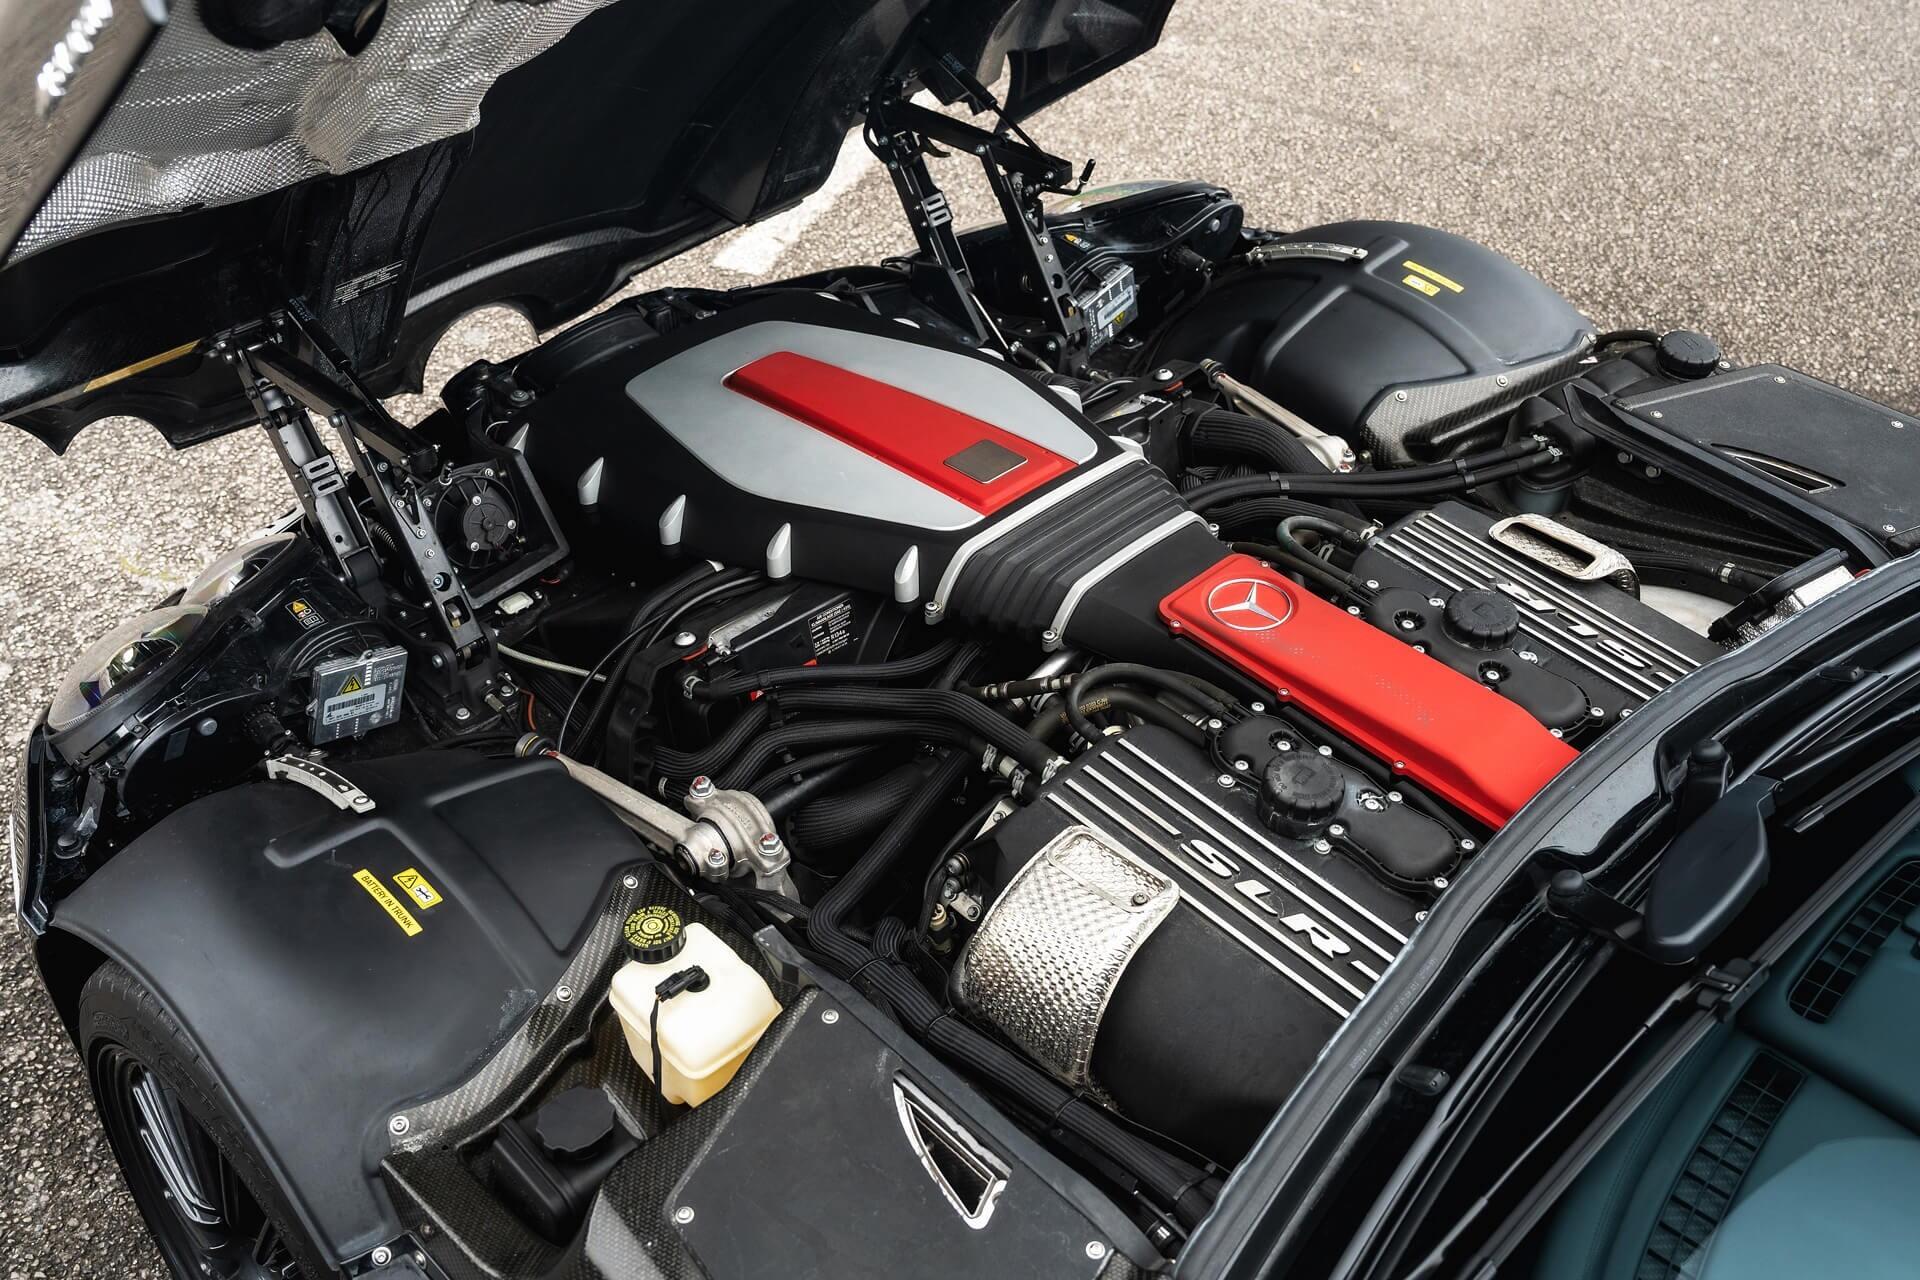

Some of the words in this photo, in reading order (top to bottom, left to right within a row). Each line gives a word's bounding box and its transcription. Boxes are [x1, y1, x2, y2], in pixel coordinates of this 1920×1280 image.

[1496, 583, 1653, 669] SLR
[361, 875, 387, 899] BATTERY
[384, 898, 394, 907] IN
[392, 905, 414, 928] TRUNK
[1179, 839, 1351, 960] SLR
